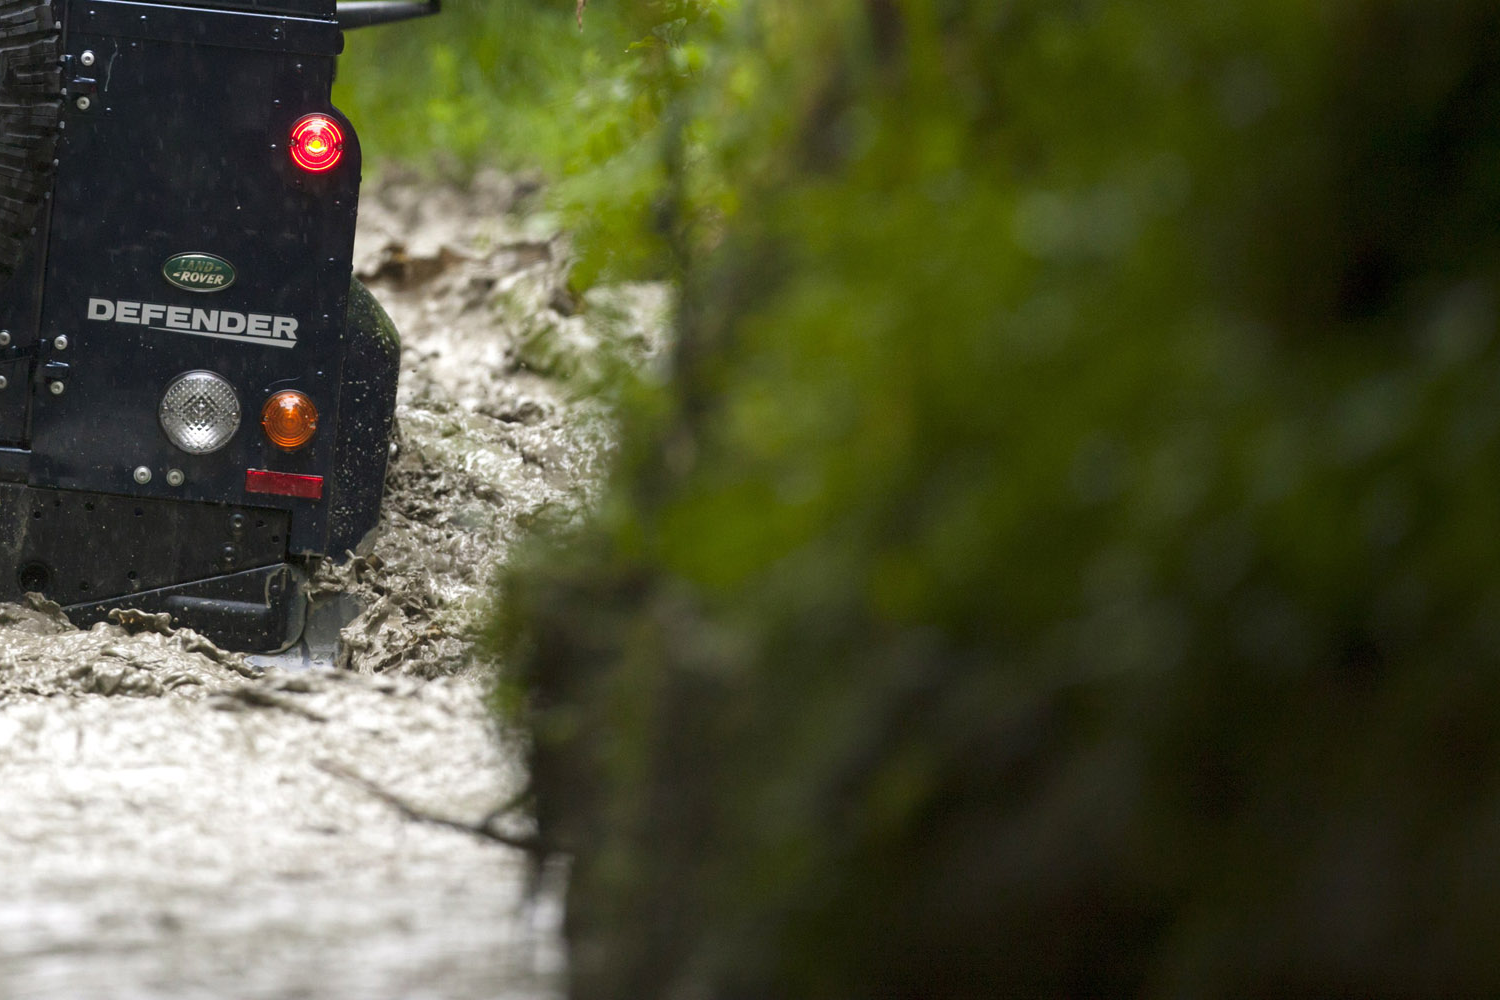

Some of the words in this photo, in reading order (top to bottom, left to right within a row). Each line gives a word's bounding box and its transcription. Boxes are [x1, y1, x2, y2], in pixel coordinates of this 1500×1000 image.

[178, 258, 214, 274] LAND
[179, 270, 225, 286] ROVER
[87, 297, 299, 340] DEFENDER
